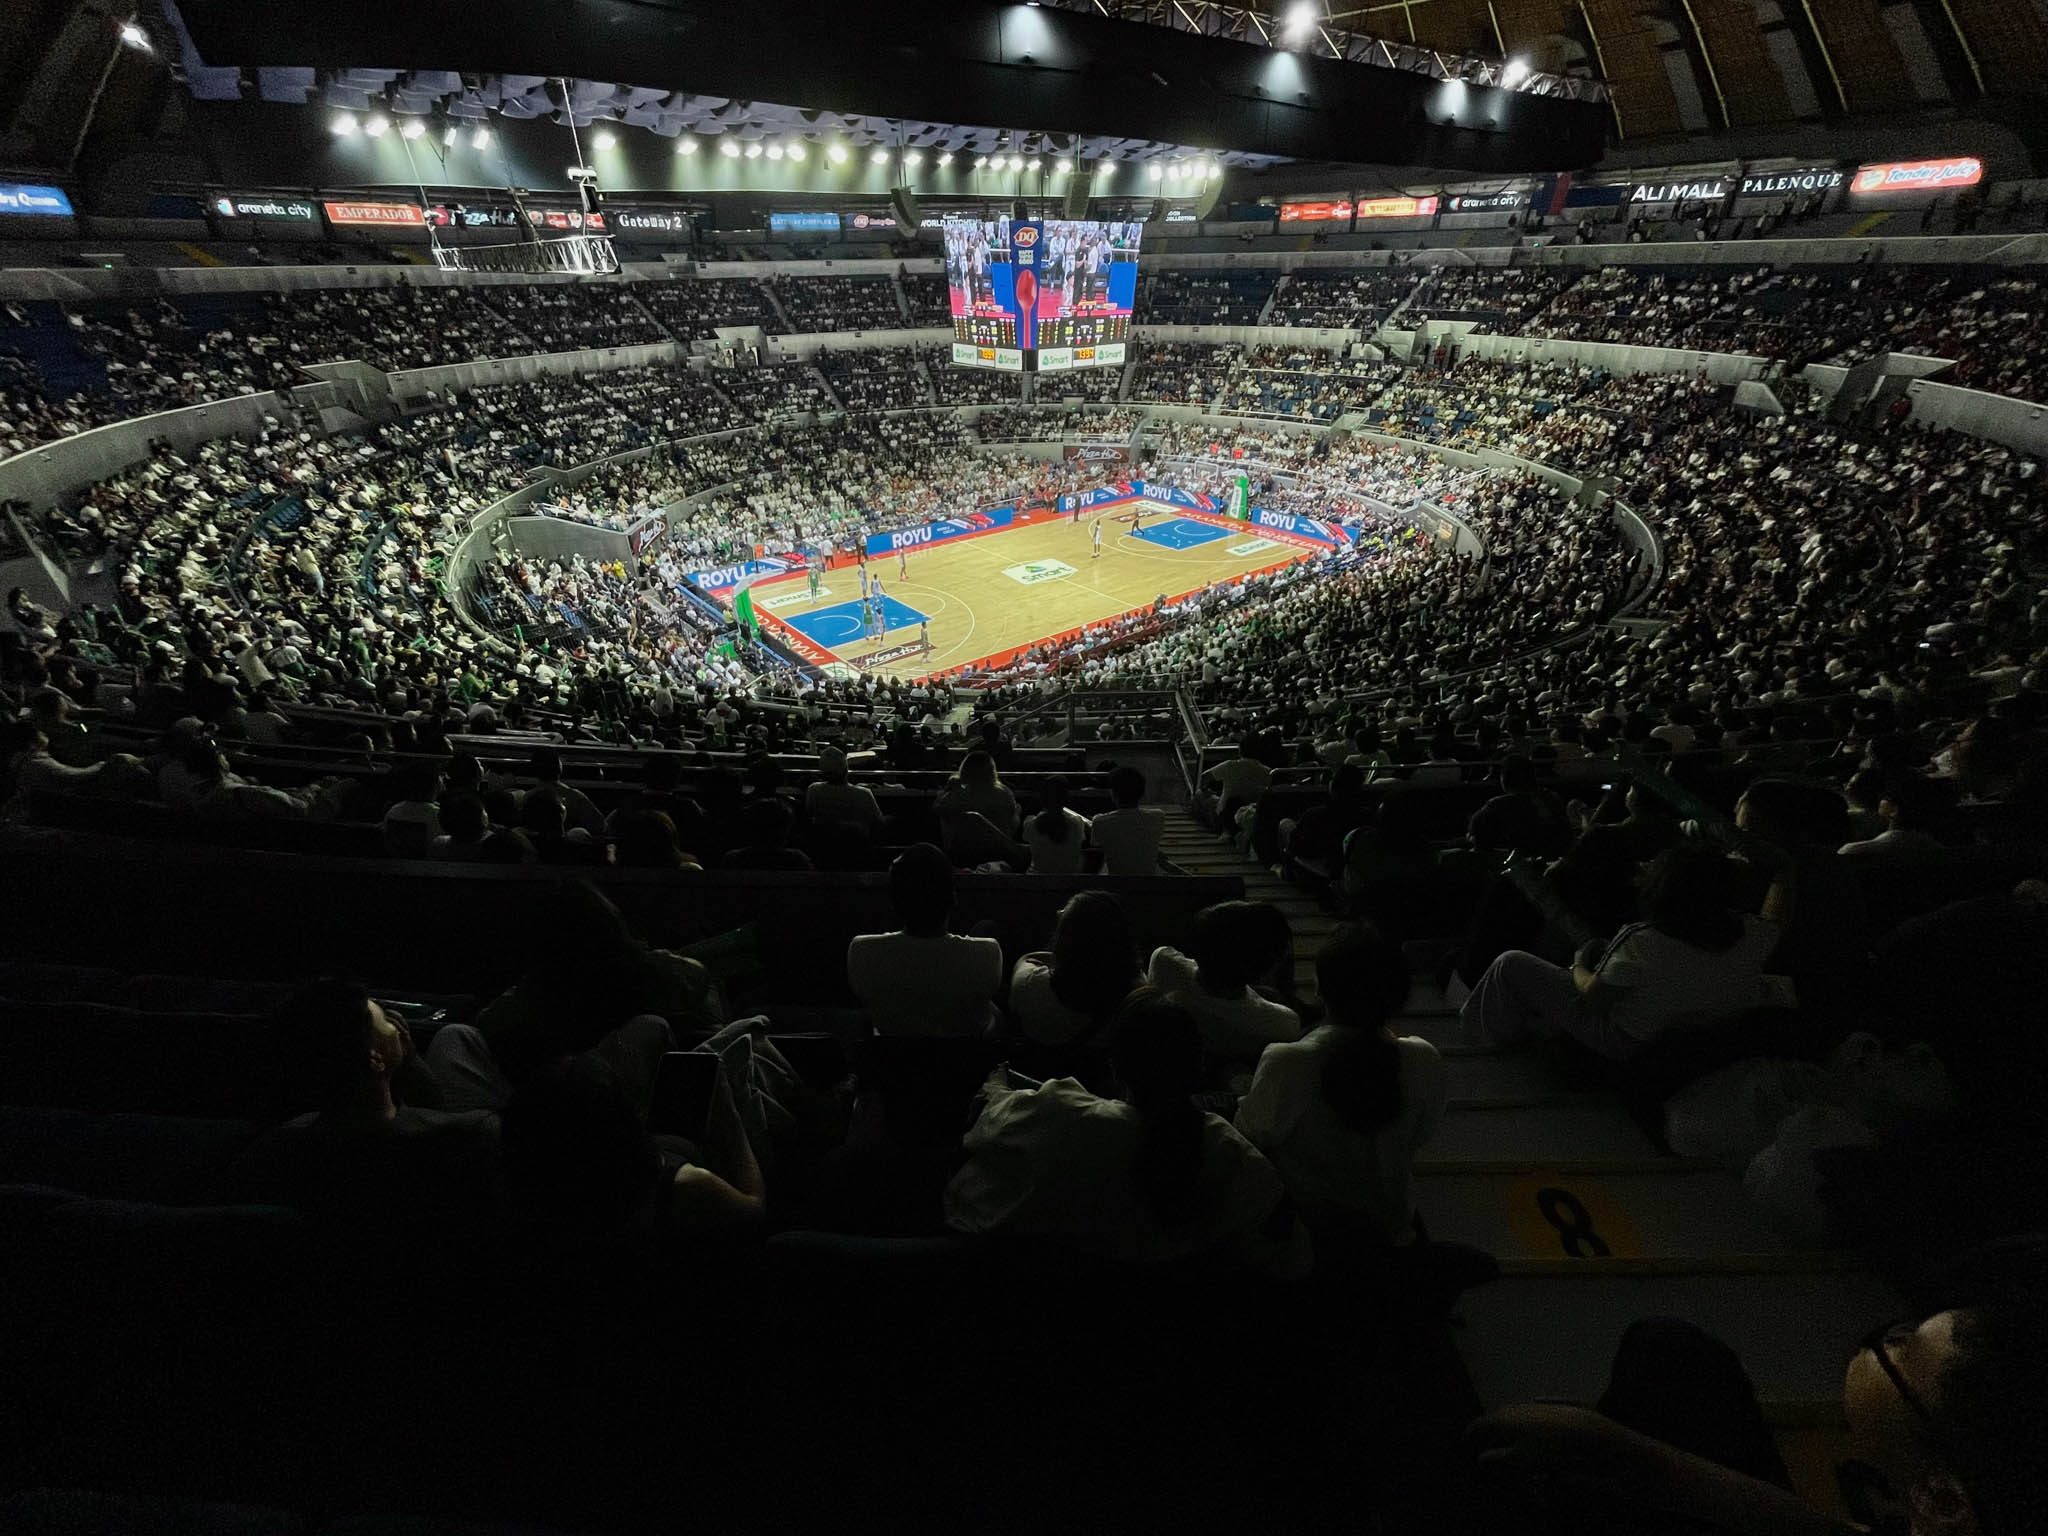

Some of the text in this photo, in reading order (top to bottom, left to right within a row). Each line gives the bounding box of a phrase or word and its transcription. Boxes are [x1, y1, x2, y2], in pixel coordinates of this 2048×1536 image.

[1886, 167, 1937, 184] Tender
[1934, 162, 1979, 179] Juicy
[1630, 182, 1725, 201] ALI MALL
[1742, 173, 1843, 193] PALENQUE
[238, 201, 312, 219] araneta city
[1500, 195, 1521, 207] city
[335, 206, 416, 221] EMPERADOR
[674, 217, 682, 228] 2
[1143, 485, 1171, 501] ROYU
[1260, 511, 1295, 531] ROYU
[892, 526, 932, 548] ROYU
[697, 565, 746, 588] ROYU
[1022, 566, 1072, 582] Smart
